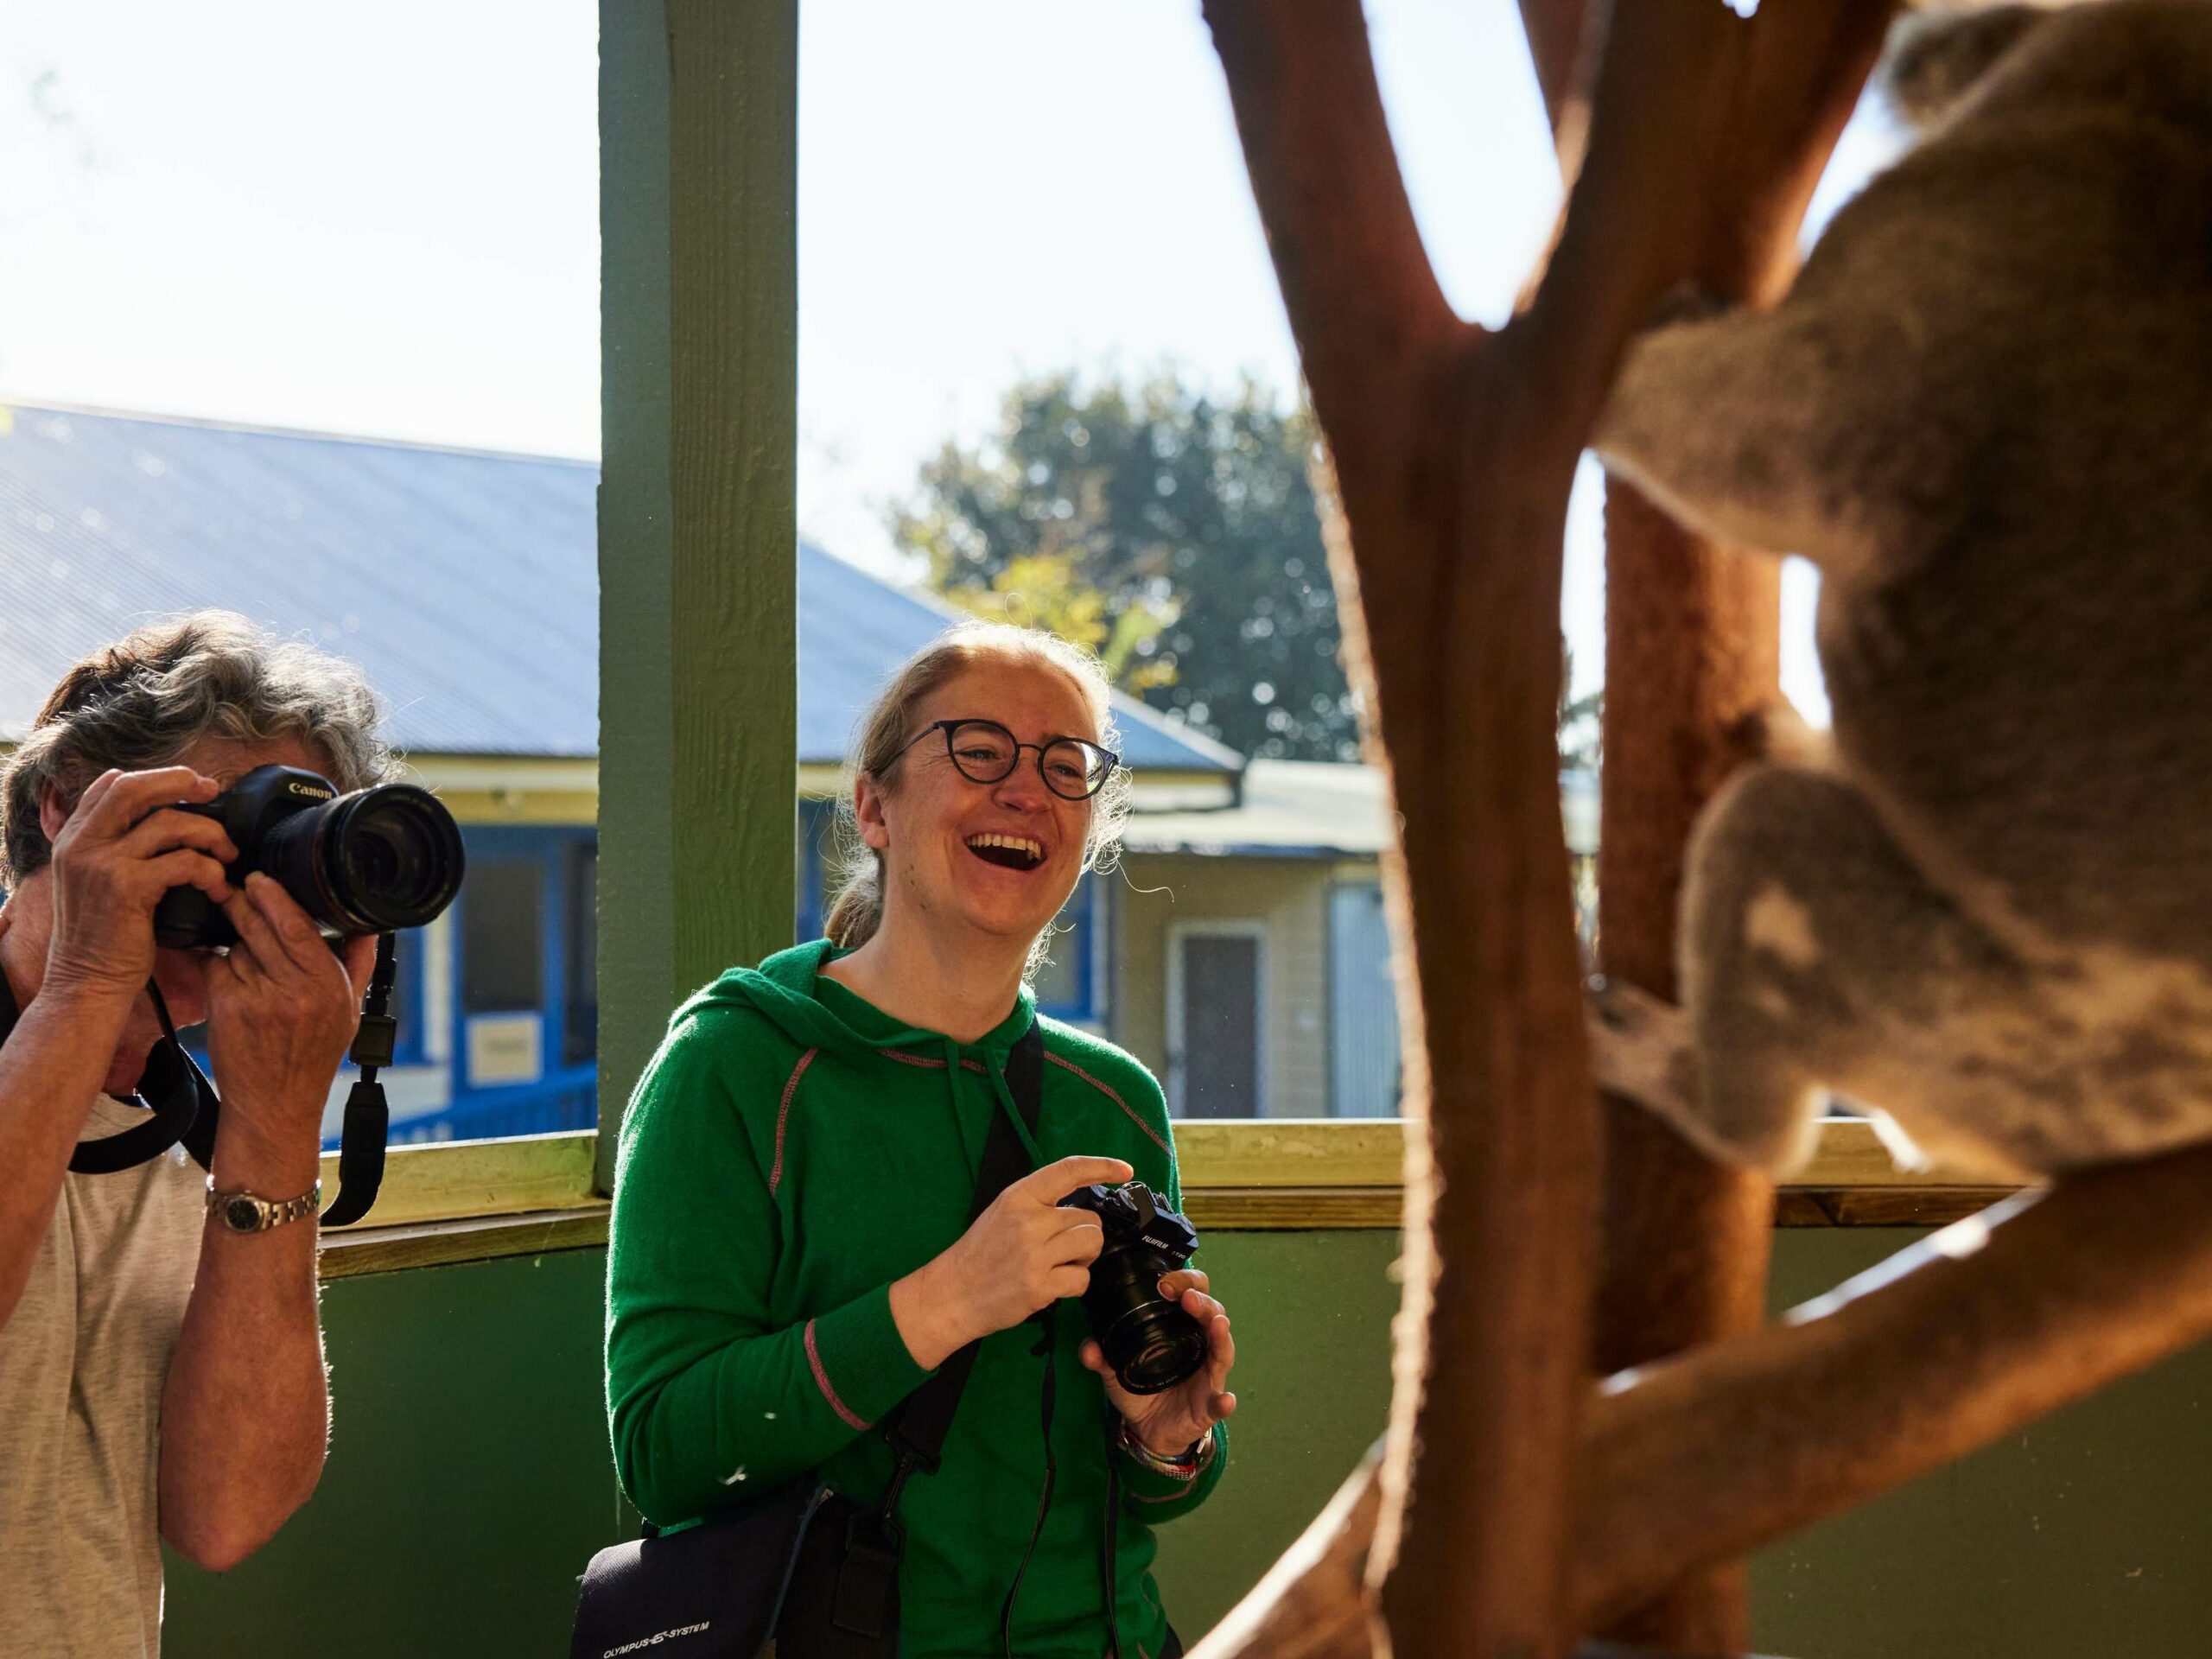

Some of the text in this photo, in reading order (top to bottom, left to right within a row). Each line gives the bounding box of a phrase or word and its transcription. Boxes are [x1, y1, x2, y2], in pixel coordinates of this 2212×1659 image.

[289, 782, 333, 799] Canon
[1141, 1235, 1169, 1249] FUJIFILM
[603, 1638, 649, 1659] OLYMPUS
[668, 1621, 710, 1638] SYSTEM
